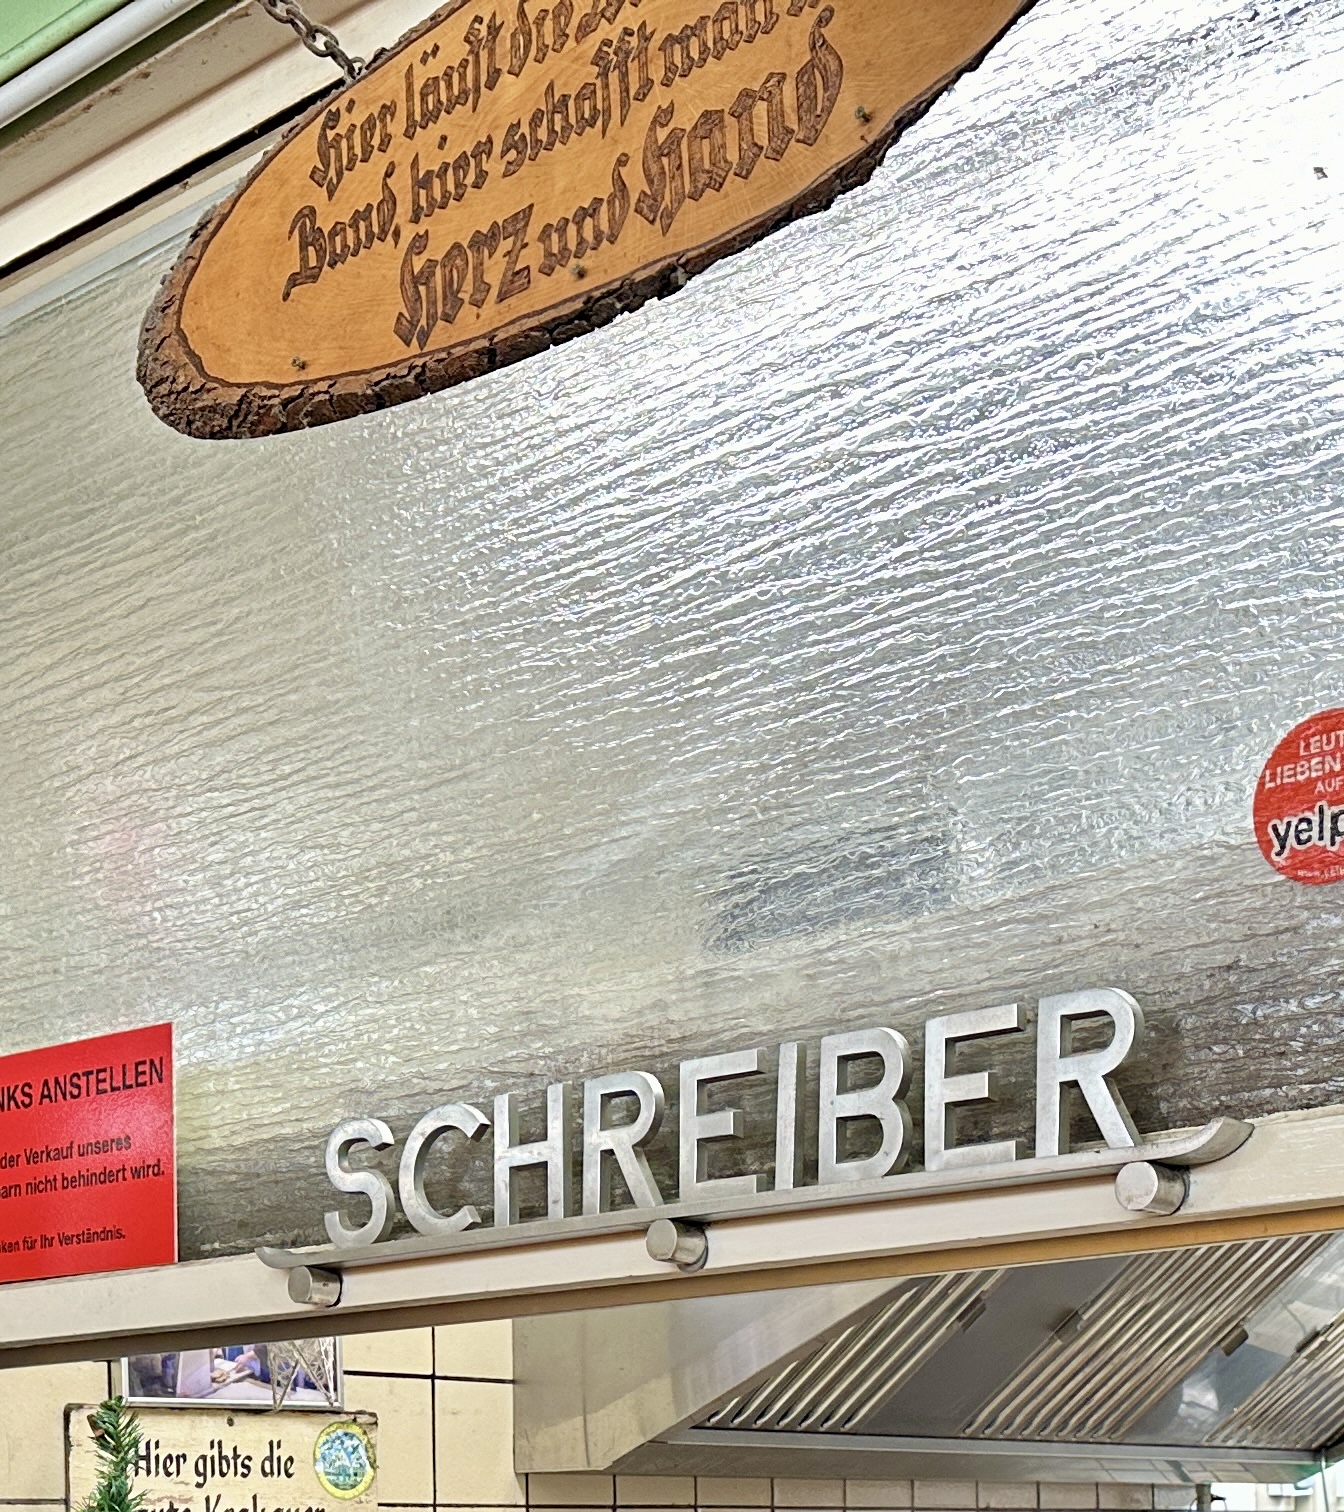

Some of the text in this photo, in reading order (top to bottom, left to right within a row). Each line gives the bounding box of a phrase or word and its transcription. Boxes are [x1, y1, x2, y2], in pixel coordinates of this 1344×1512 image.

[403, 10, 505, 141] läuft
[282, 162, 402, 300] Band,
[409, 133, 493, 224] hier
[500, 19, 657, 177] schafft
[393, 4, 844, 351] Herz und Hand
[1264, 751, 1342, 789] LIEBEN
[1314, 776, 1344, 795] AUF
[38, 1056, 164, 1106] ANSTELLEN
[324, 987, 1146, 1248] SCHREIBER
[0, 1152, 20, 1170] der
[23, 1141, 74, 1165] Verkauf
[77, 1134, 132, 1157] unseres
[26, 1175, 58, 1196] nicht
[61, 1164, 127, 1191] behindert
[130, 1158, 165, 1179] wird.
[22, 1235, 37, 1251] für
[40, 1233, 55, 1249] Ihr
[57, 1225, 126, 1246] Verständnis.
[133, 1438, 295, 1488] Hier gibts die
